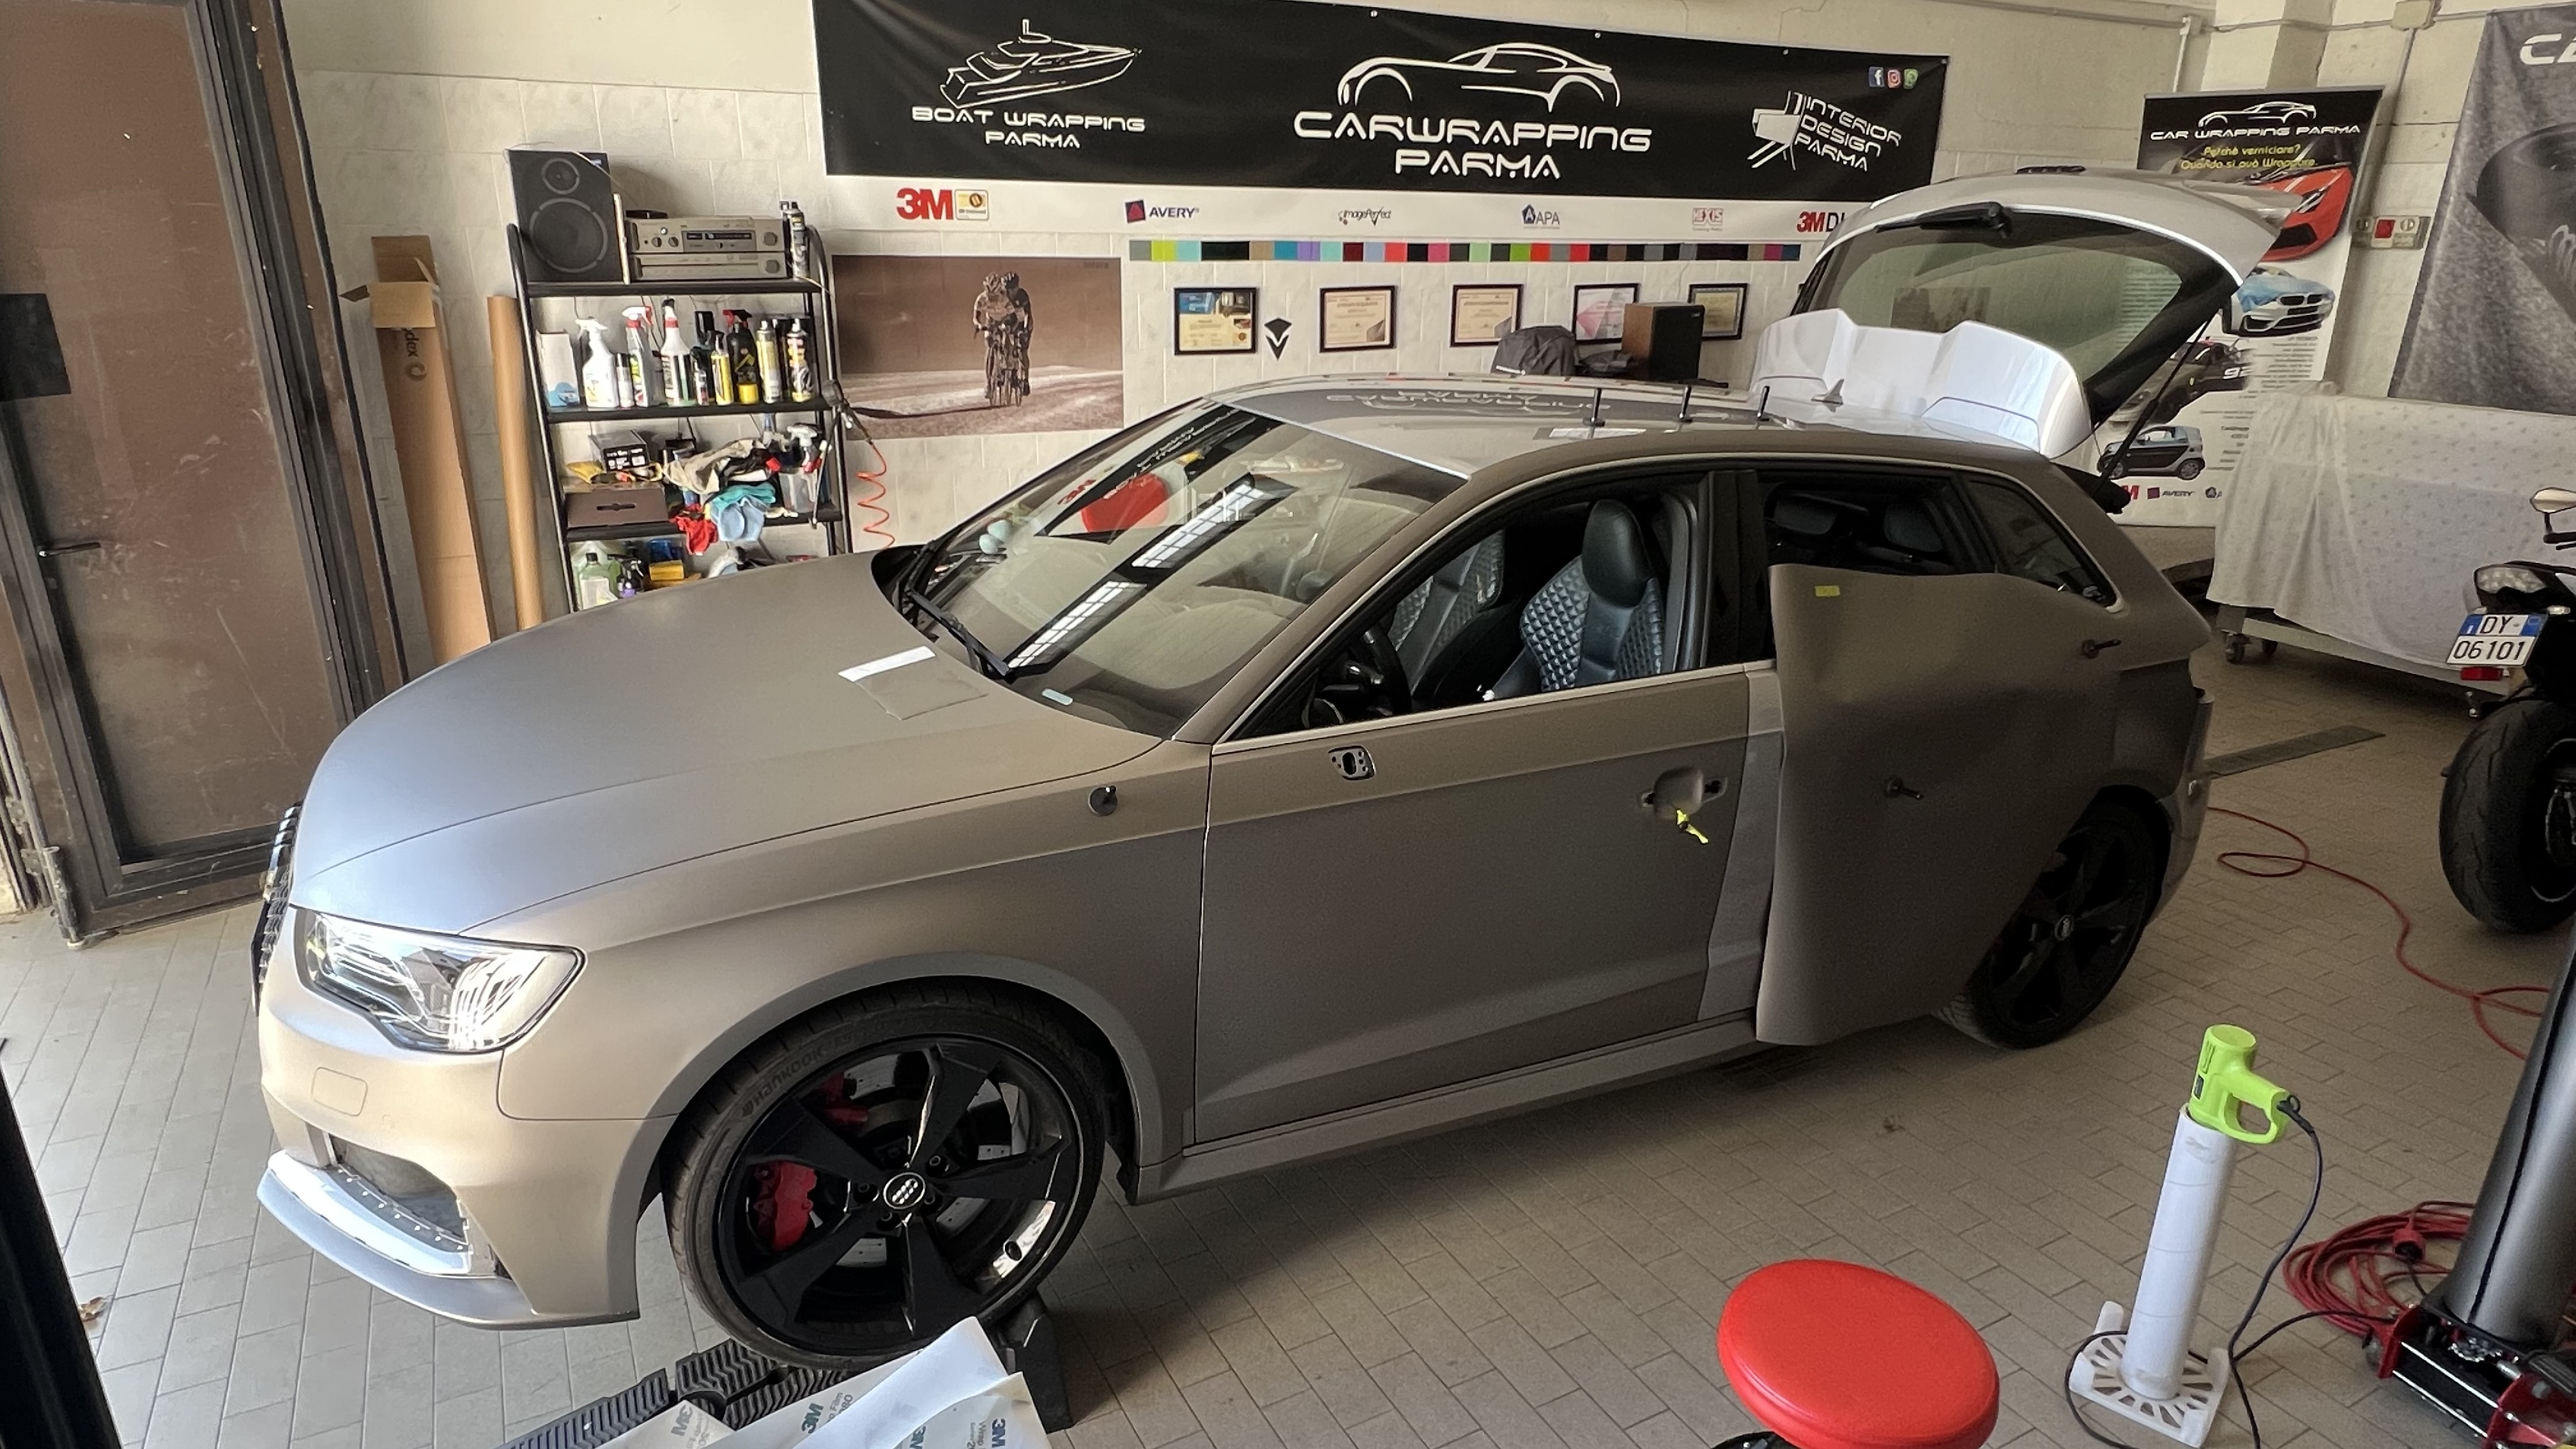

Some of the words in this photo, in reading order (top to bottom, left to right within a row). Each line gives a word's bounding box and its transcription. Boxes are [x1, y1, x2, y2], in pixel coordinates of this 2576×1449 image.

[912, 107, 993, 123] BOAT
[1004, 112, 1145, 132] WRAPPING
[1294, 111, 1652, 152] CARWRAPPING
[1806, 96, 1901, 146] INTERIOR
[2150, 130, 2189, 141] CAR
[2195, 127, 2290, 139] WRAPPING
[2296, 125, 2361, 135] PARMA
[985, 130, 1080, 148] PARMA
[1801, 114, 1882, 157] DESIGN
[1395, 149, 1560, 179] PARMA
[1794, 132, 1867, 172] PARMA
[896, 187, 954, 220] 3M
[1535, 211, 1560, 225] APA
[2480, 616, 2513, 634] DY
[2453, 640, 2526, 661] 06101
[801, 1402, 824, 1434] 3M
[992, 1418, 1006, 1448] 3M
